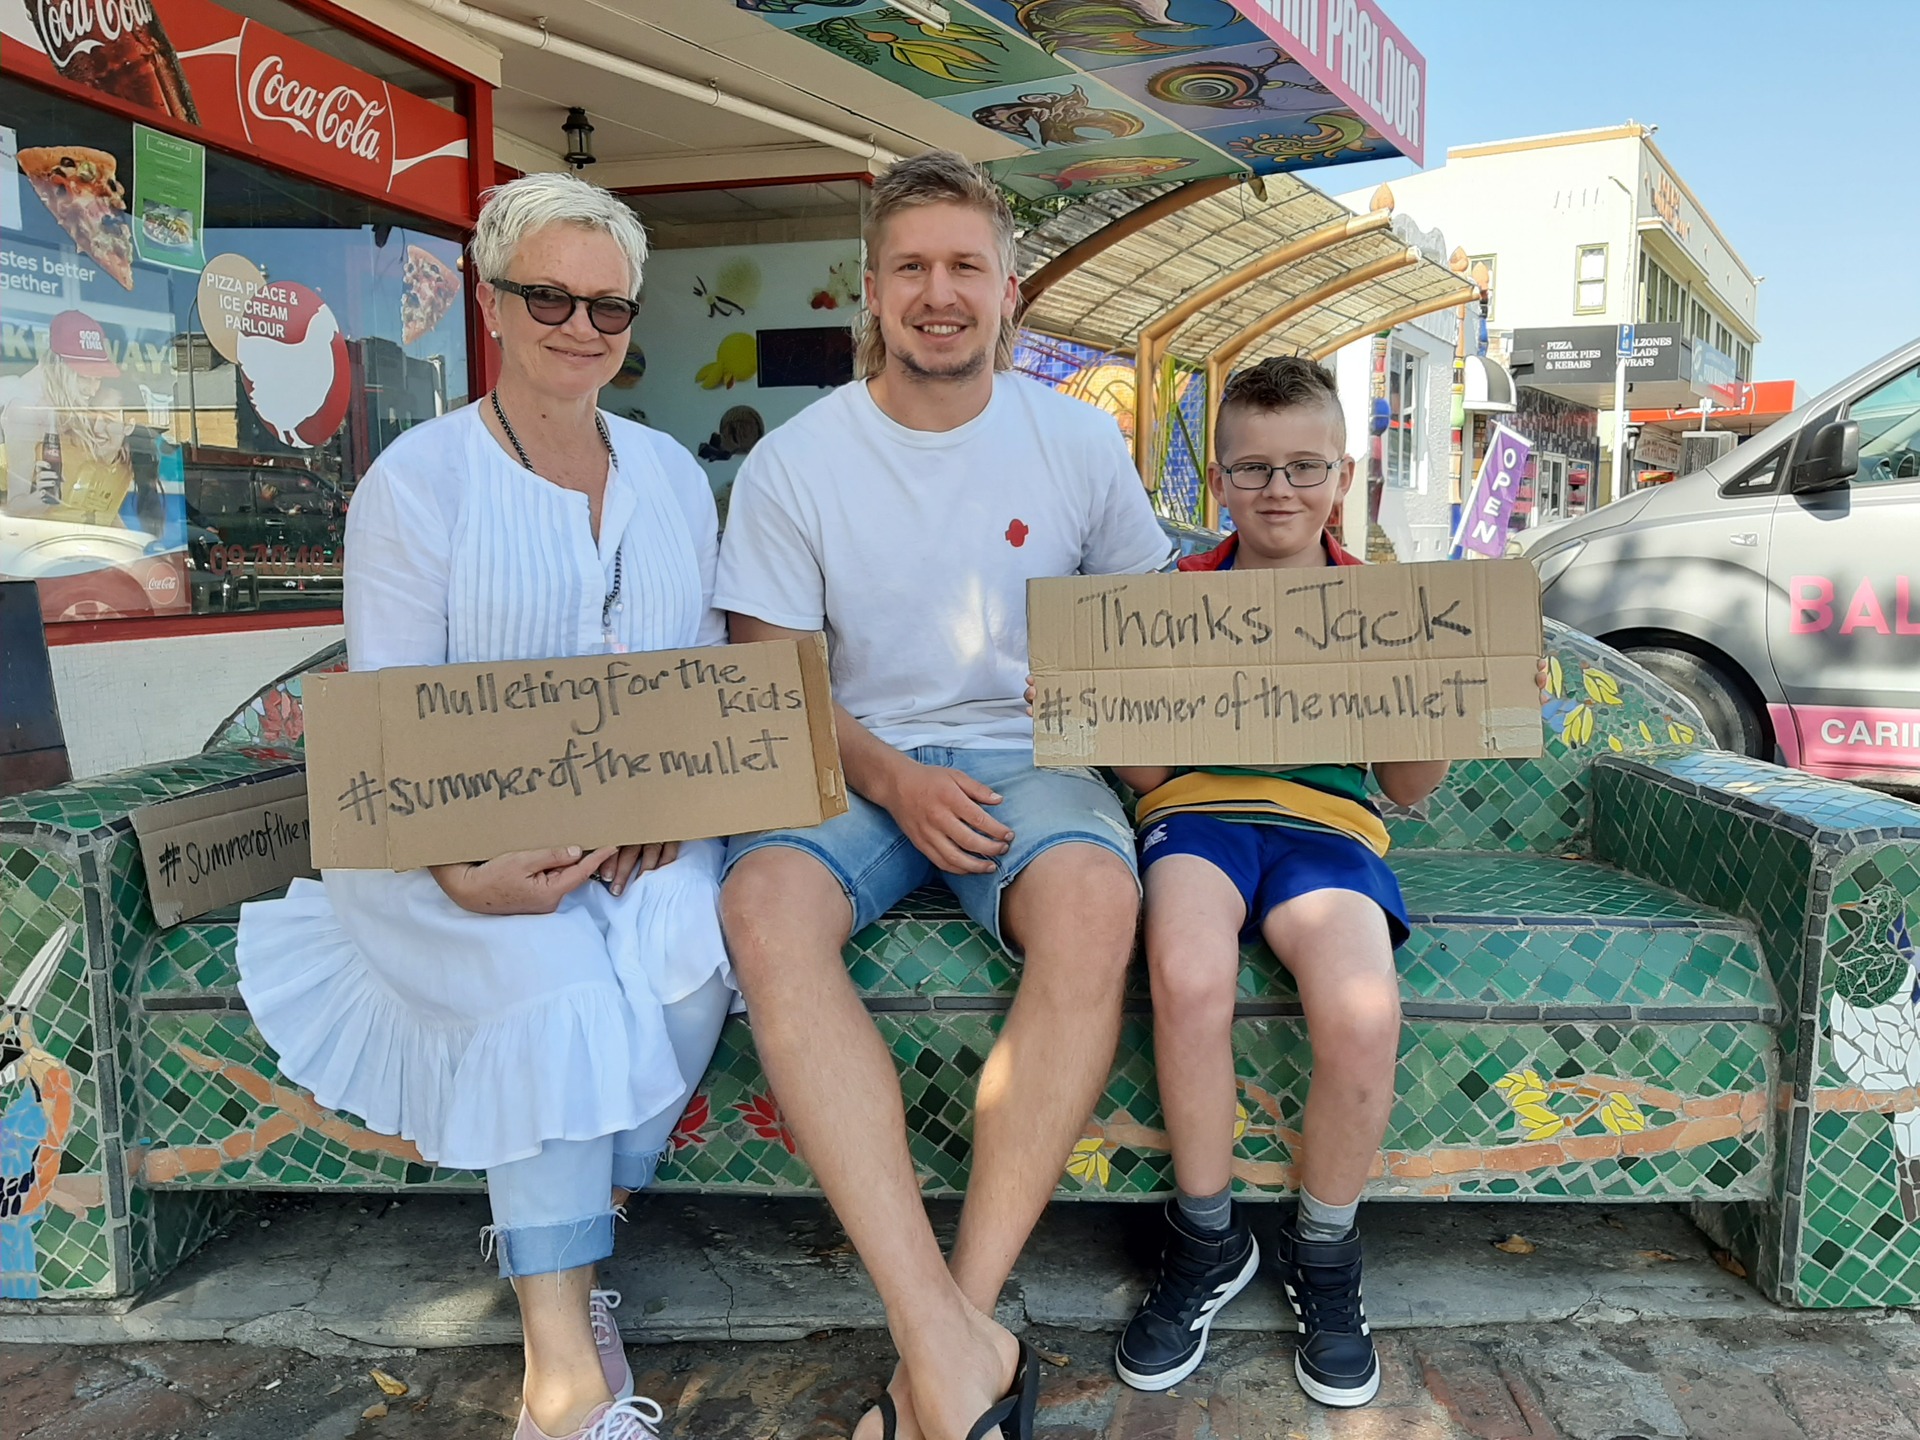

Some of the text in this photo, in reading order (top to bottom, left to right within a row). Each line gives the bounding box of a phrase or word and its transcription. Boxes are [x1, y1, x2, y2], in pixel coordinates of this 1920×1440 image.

[1326, 0, 1420, 148] PARLOUR
[248, 55, 387, 161] Coca-Cola
[43, 257, 96, 283] better
[0, 272, 59, 295] gether
[206, 272, 298, 306] PIZZA PLACE &
[219, 294, 288, 321] ICE CREAM
[225, 314, 285, 338] PARLOUR
[1546, 341, 1573, 350] PIZZA
[1546, 350, 1601, 360] GREEK PIES
[1632, 337, 1672, 347] LZONES
[1632, 348, 1658, 357] LADS
[1545, 360, 1592, 370] & KEBABS
[1471, 448, 1517, 544] OPEN
[1077, 580, 1472, 653] Thanks Jack
[1789, 575, 1920, 636] BAL
[415, 658, 747, 736] Mulleting for the
